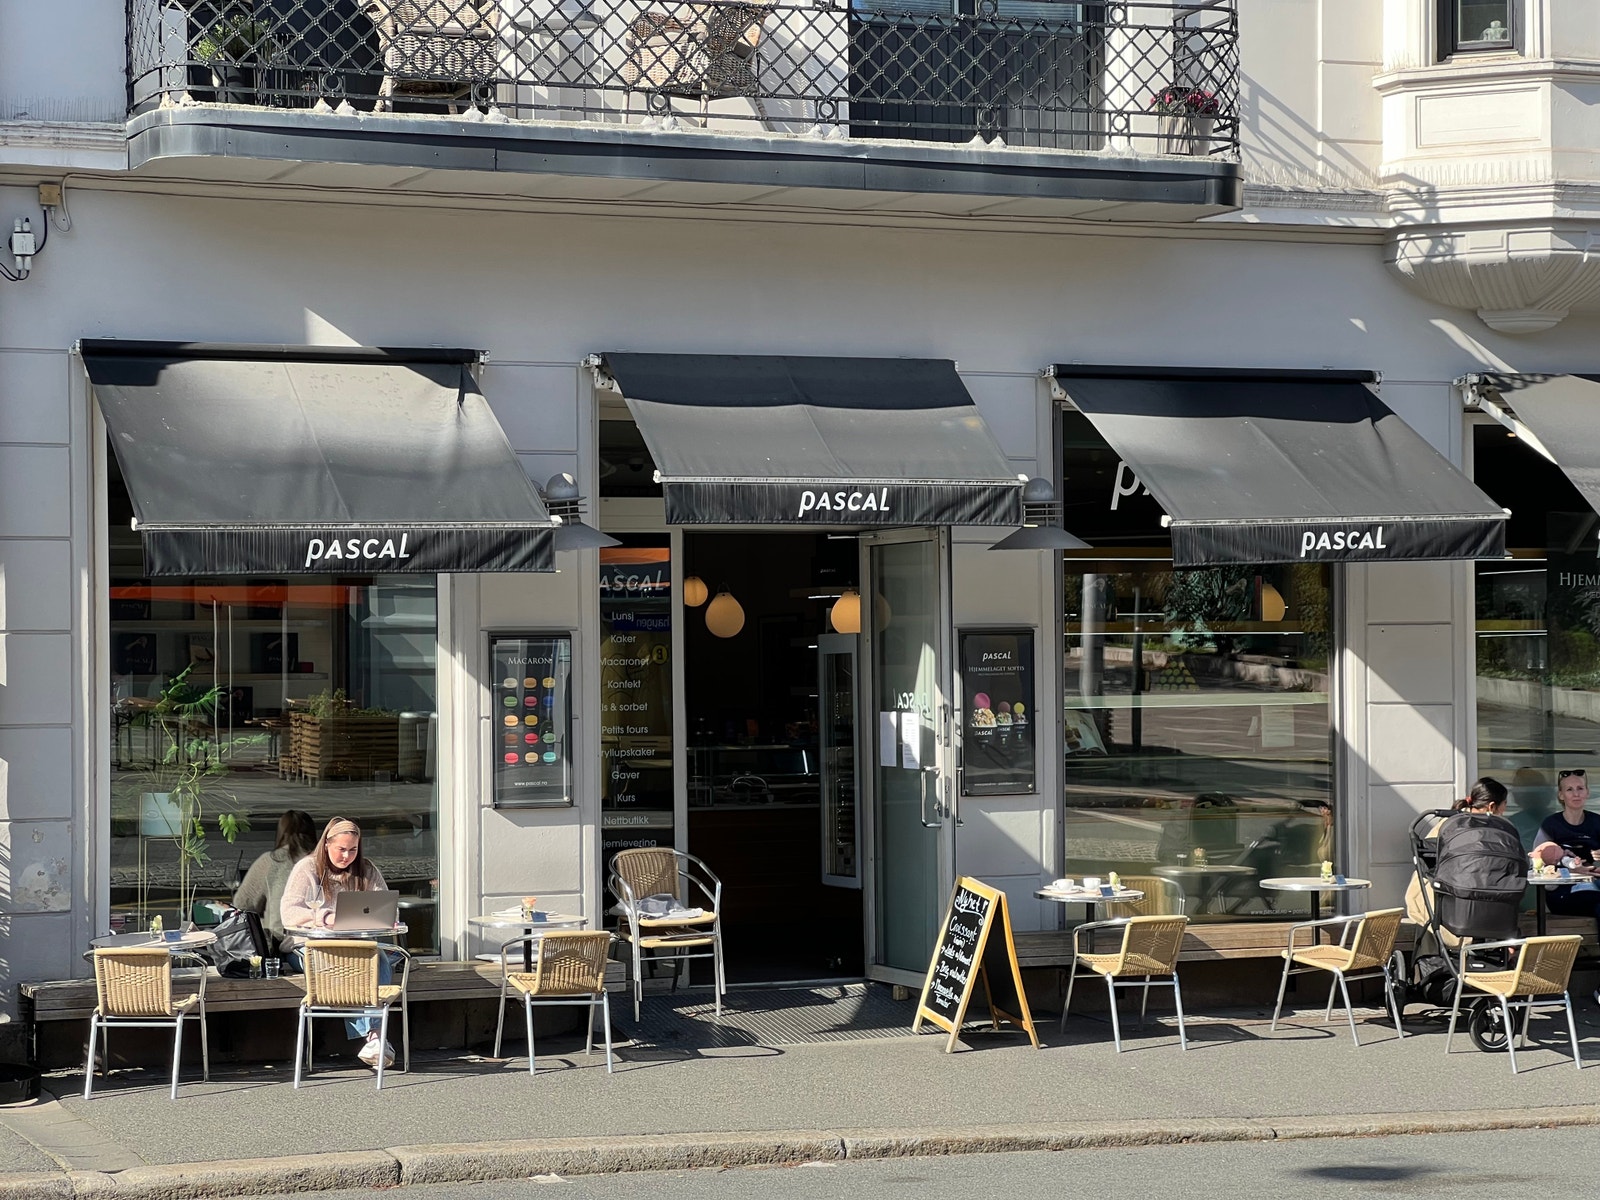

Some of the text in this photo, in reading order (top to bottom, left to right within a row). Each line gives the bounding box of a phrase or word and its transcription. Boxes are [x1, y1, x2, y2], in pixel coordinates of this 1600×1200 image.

[600, 570, 664, 591] ASCAL
[611, 611, 634, 622] Lunsj
[610, 635, 637, 643] Kaker
[607, 680, 641, 689] Konfekt
[610, 703, 617, 711] &
[619, 702, 648, 711] sorbet
[601, 725, 649, 734] Petits fours
[601, 748, 655, 758] ryllupskaker
[611, 771, 640, 780] Gaver
[617, 793, 636, 802] Kurs
[604, 816, 649, 825] Nettbutikk
[601, 838, 657, 849] jemlevering
